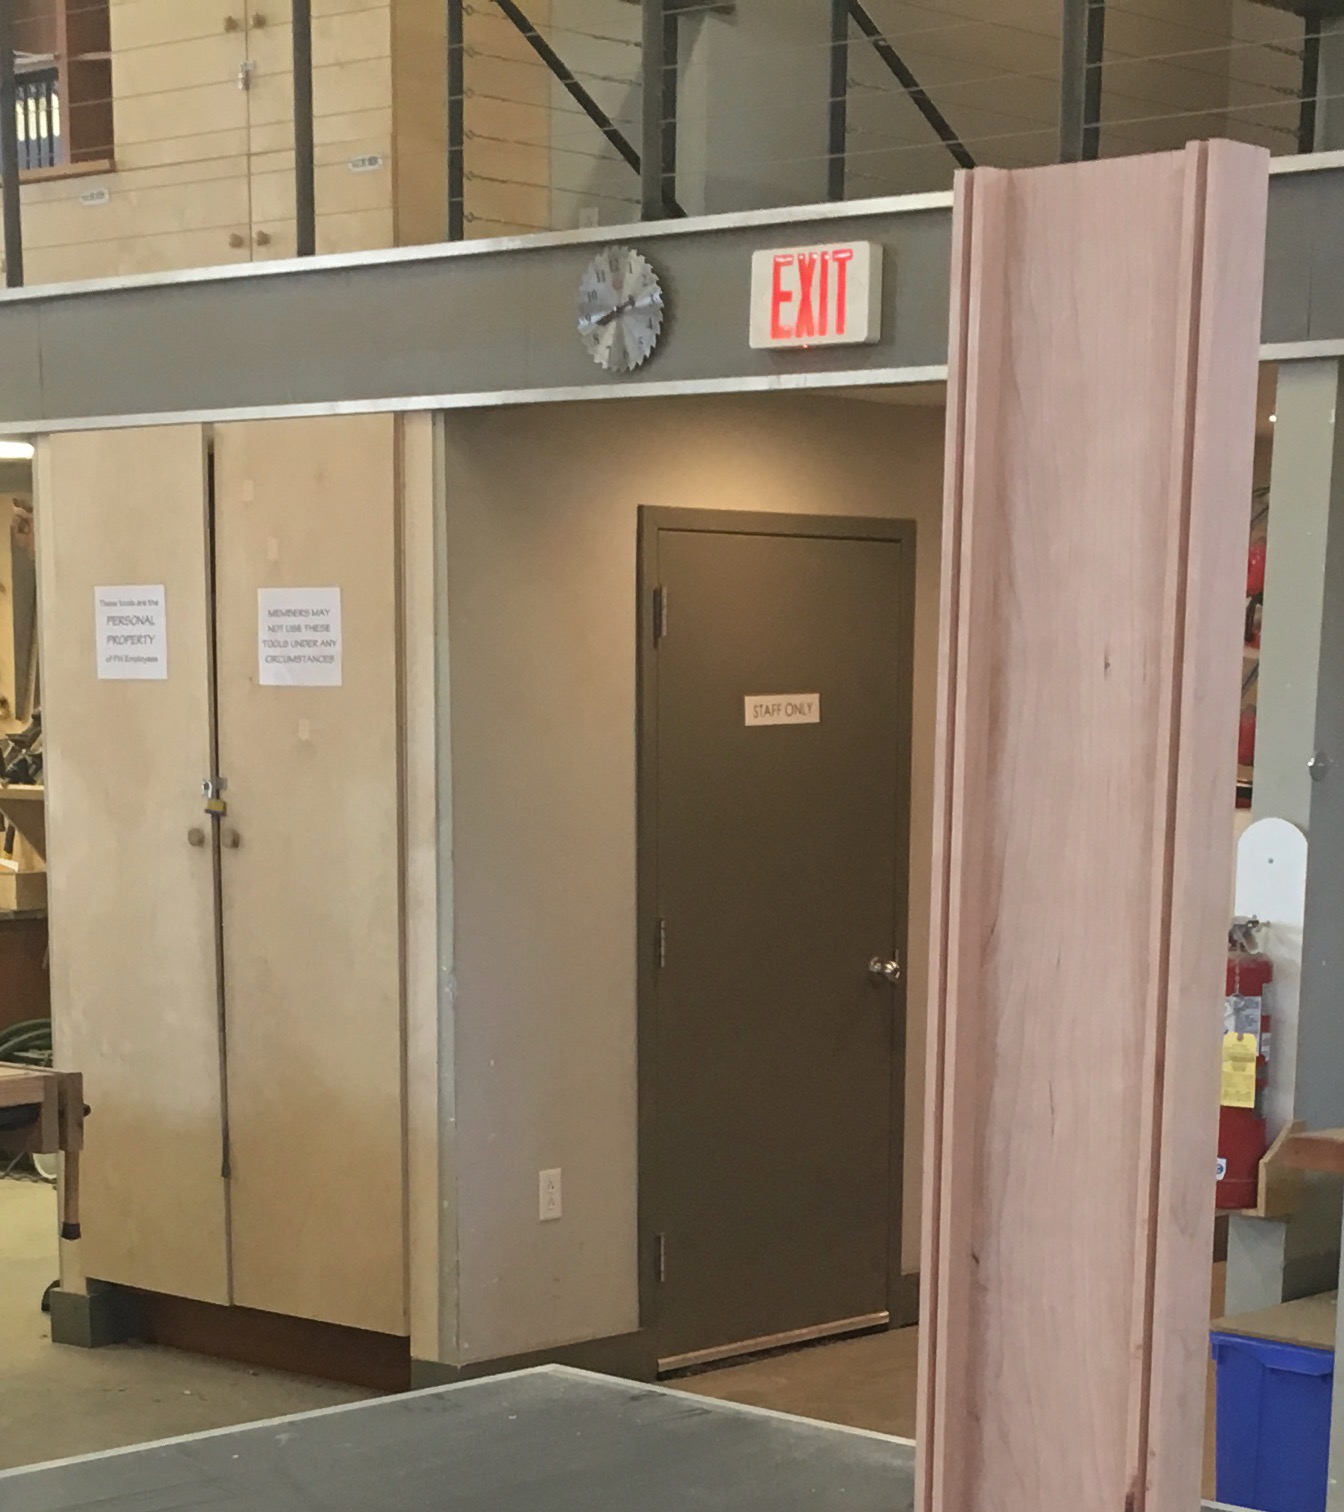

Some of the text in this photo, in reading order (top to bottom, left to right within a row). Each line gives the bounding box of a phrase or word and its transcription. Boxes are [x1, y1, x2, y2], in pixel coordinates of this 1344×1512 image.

[769, 247, 854, 340] EXIT
[267, 608, 331, 617] MEMBERS MAY
[105, 614, 156, 626] PERSONAL
[267, 624, 331, 633] NOT USE THESE
[106, 634, 156, 645] PROPERTY
[262, 639, 337, 648] TOOLS UNDER ANY
[264, 654, 335, 664] CIRCUMSTANCES
[752, 702, 814, 719] STAFF ONLY
